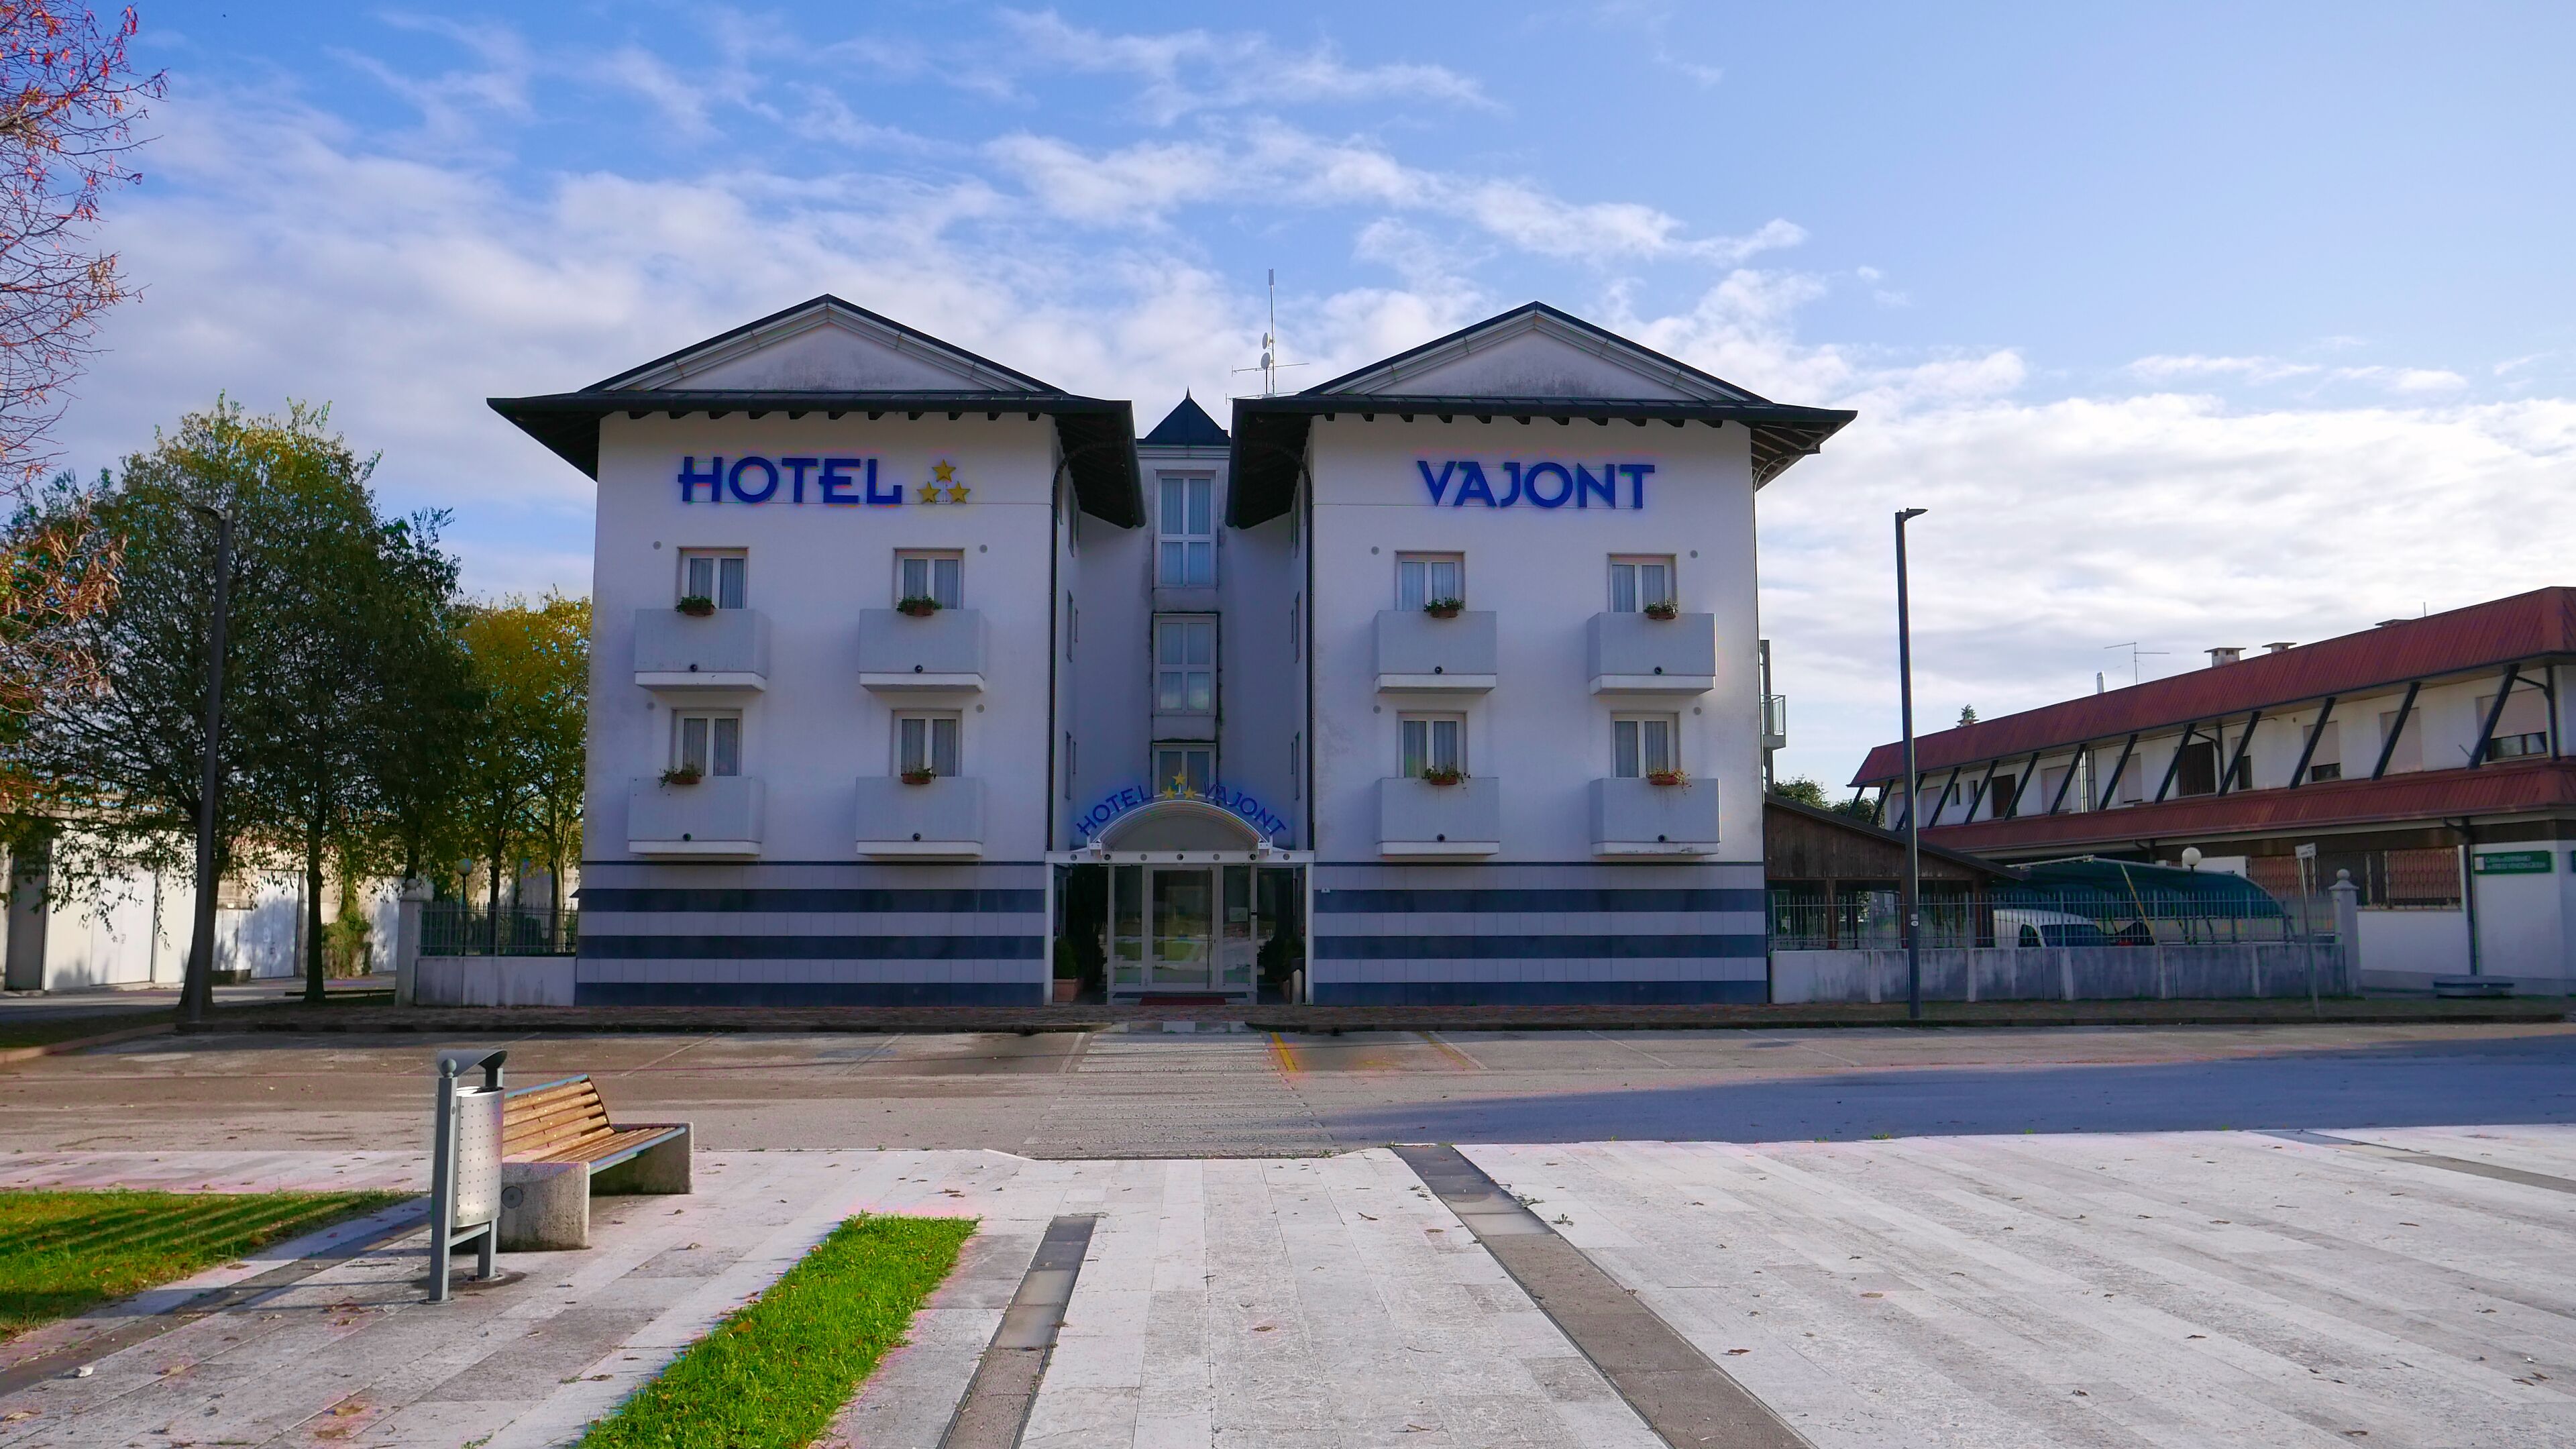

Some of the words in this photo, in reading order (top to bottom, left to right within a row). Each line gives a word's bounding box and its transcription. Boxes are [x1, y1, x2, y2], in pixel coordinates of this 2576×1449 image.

[678, 456, 902, 504] HOTEL
[1417, 460, 1656, 510] VAJONT
[1076, 784, 1155, 837] HOTEL
[1203, 782, 1287, 836] VAJONT
